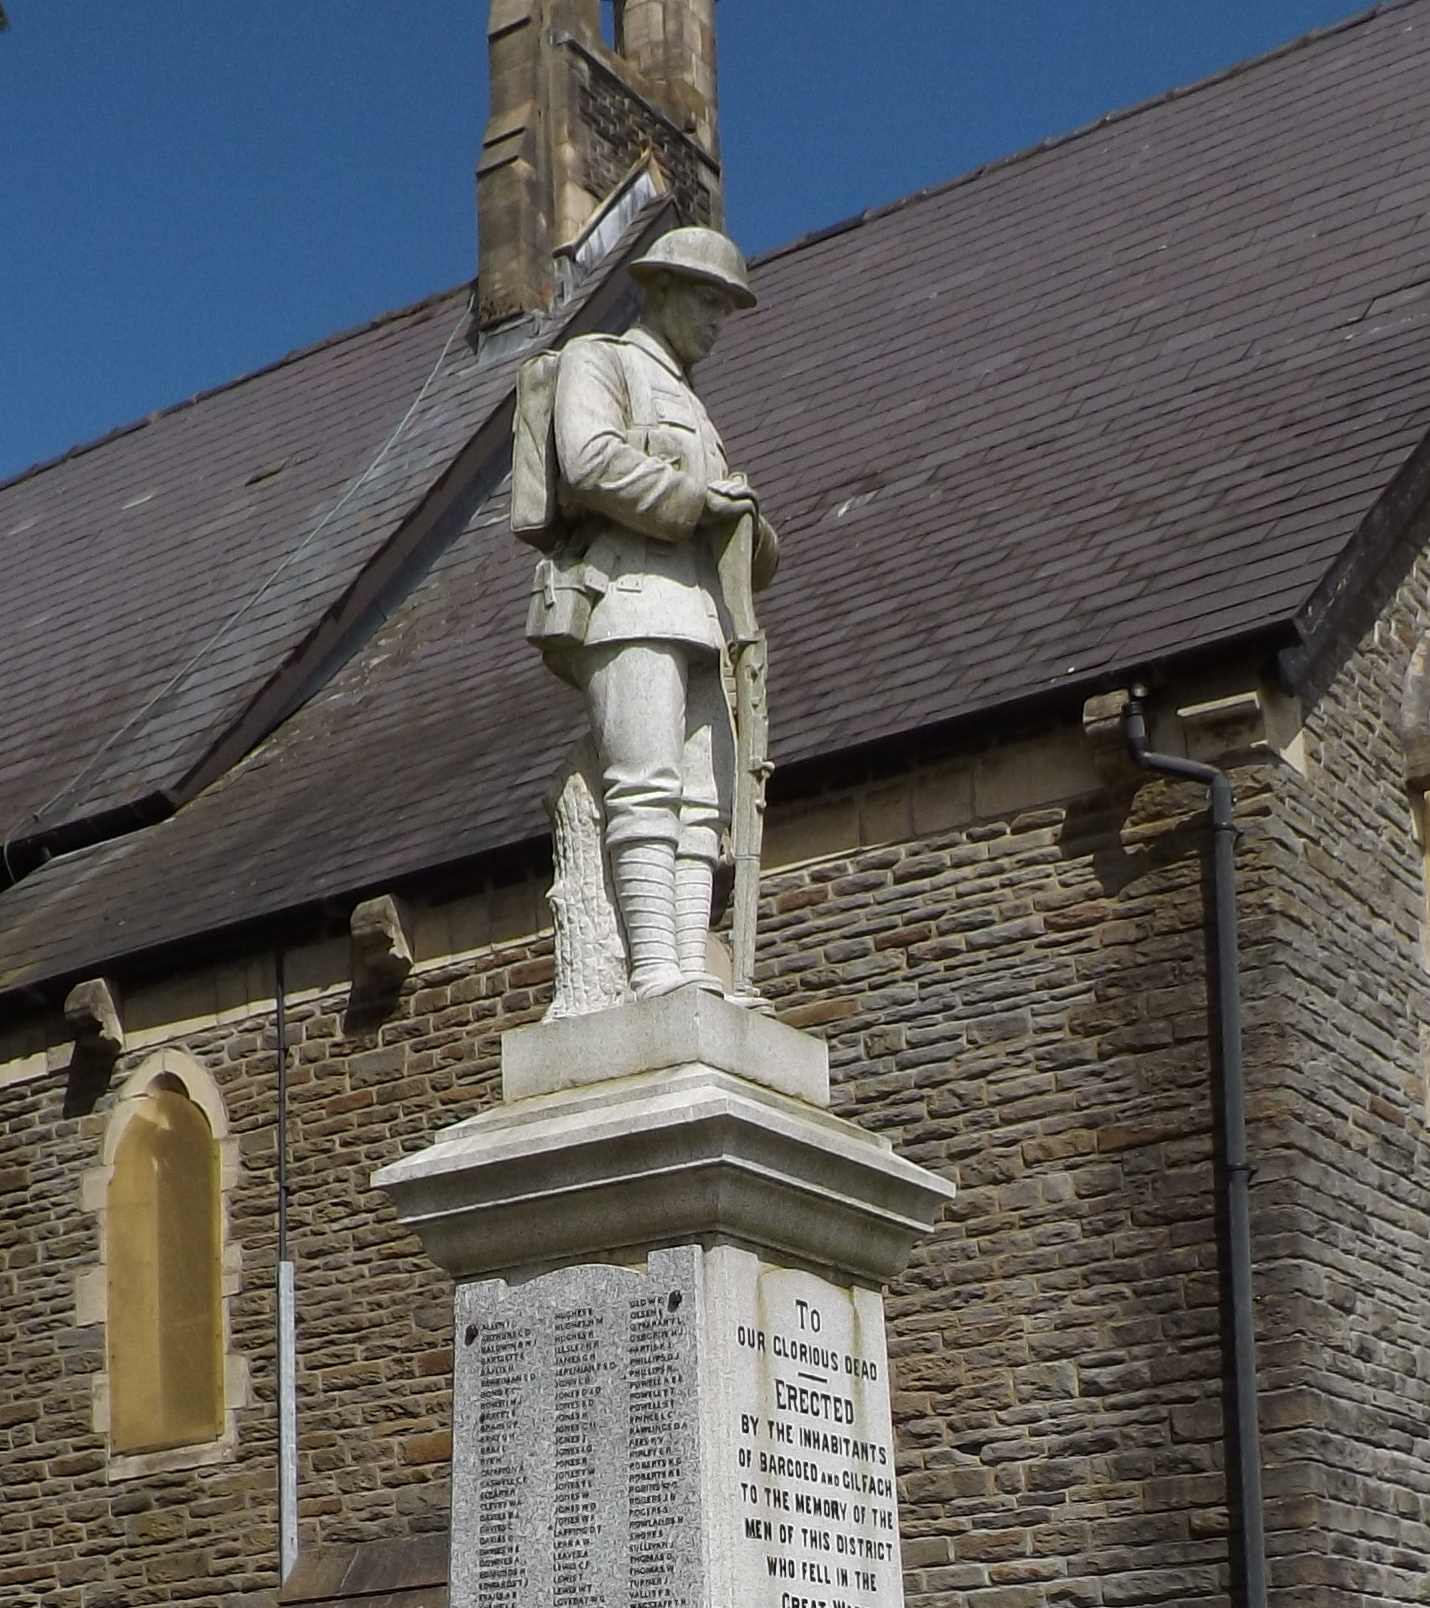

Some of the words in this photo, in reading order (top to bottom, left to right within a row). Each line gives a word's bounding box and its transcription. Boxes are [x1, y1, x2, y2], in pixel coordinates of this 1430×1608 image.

[795, 1299, 821, 1332] TO
[738, 1326, 766, 1352] OUR
[773, 1335, 838, 1371] GLORIOUS
[845, 1355, 877, 1381] DEAD
[775, 1378, 854, 1424] ERECTED
[741, 1414, 759, 1436] BY
[768, 1420, 793, 1443] THE
[800, 1427, 887, 1465] INHABITANTS
[739, 1448, 751, 1468] OF
[760, 1452, 817, 1482] BARGOED
[821, 1472, 839, 1486] AND
[843, 1471, 892, 1498] GILFACH
[741, 1483, 757, 1503] TO
[764, 1487, 789, 1511] THE
[795, 1493, 847, 1520] MEMORY
[853, 1505, 866, 1524] OF
[872, 1508, 893, 1530] THE
[745, 1518, 772, 1541] MEN
[780, 1524, 794, 1544] OF
[801, 1528, 829, 1551] THIS
[837, 1534, 892, 1561] DISTRICT
[767, 1556, 795, 1578] WHO
[802, 1562, 830, 1584] FELL
[837, 1568, 848, 1587] IN
[855, 1571, 877, 1592] THE
